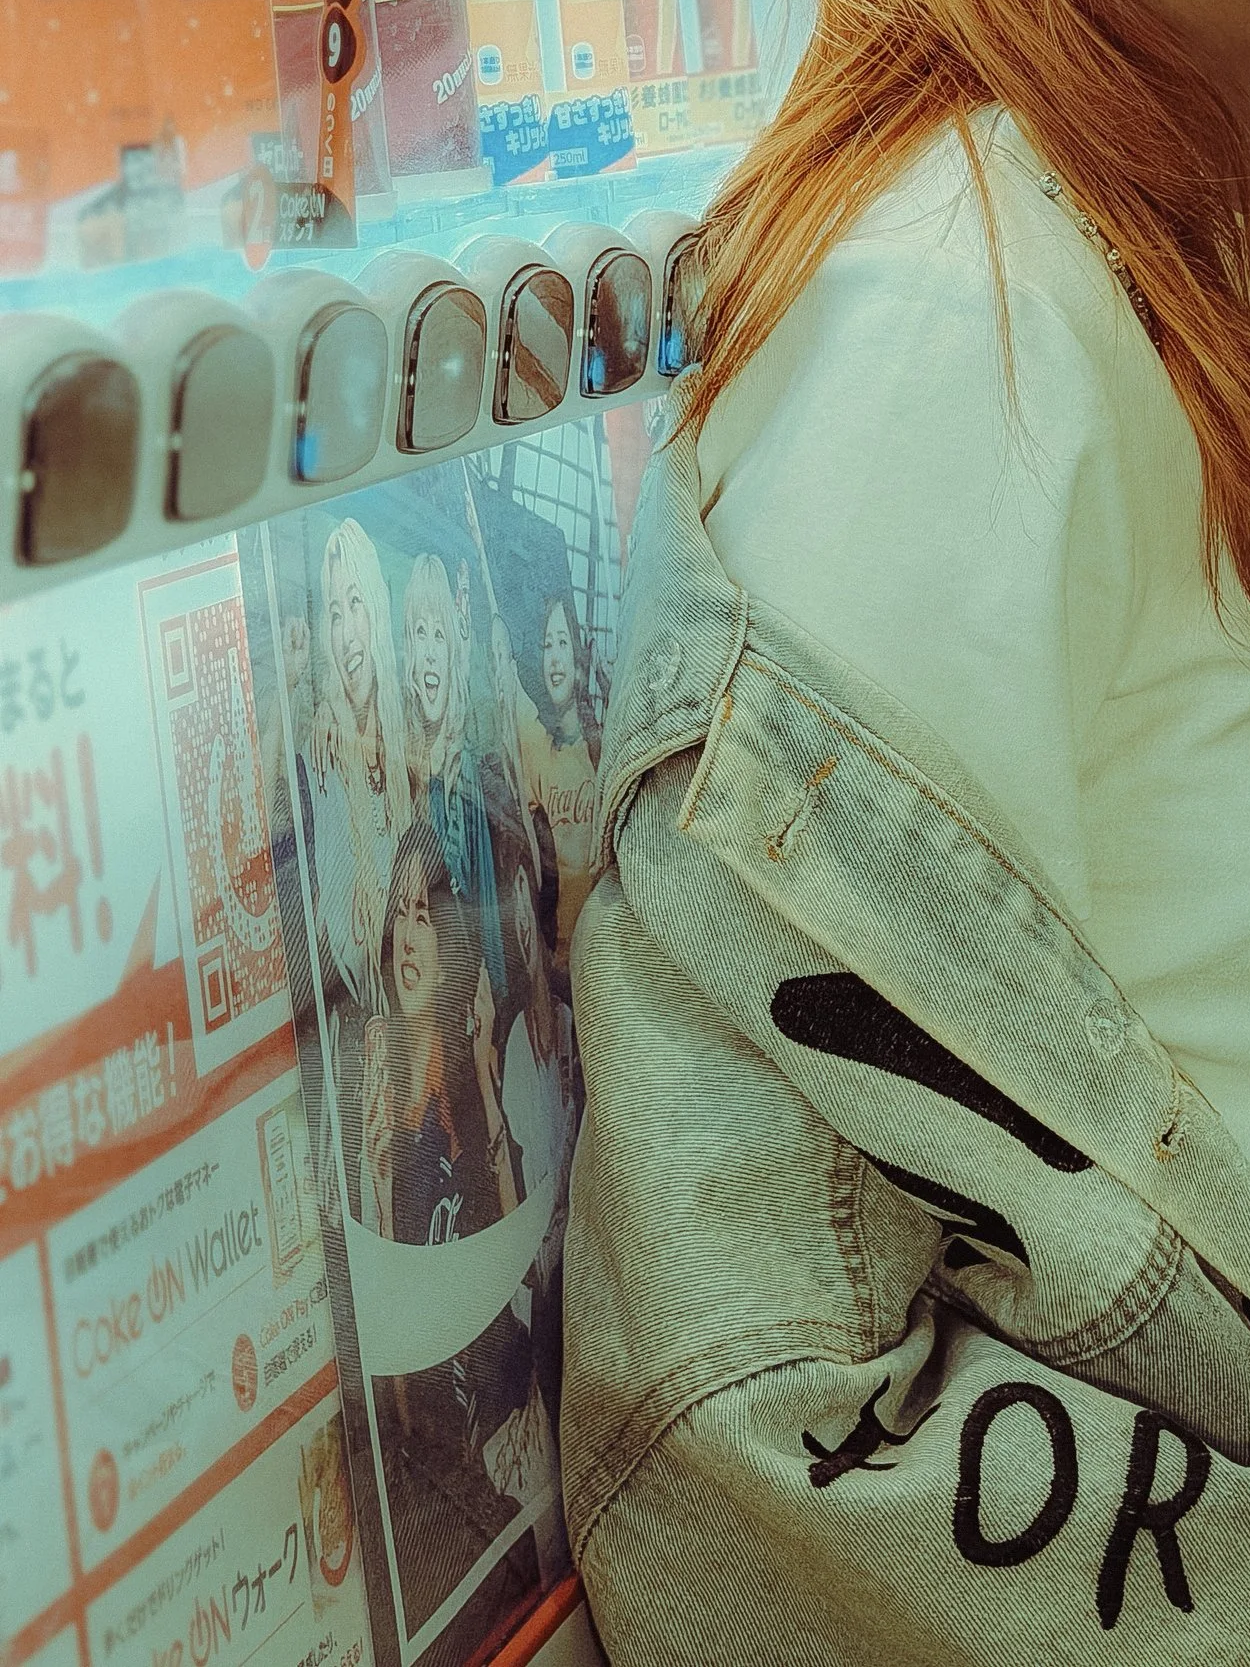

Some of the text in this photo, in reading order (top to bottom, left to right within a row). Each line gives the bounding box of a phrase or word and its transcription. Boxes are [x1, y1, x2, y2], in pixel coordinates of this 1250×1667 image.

[328, 22, 342, 68] 9
[321, 92, 337, 179] のつく日
[553, 149, 586, 165] 250ml
[279, 192, 311, 219] Coke
[74, 1200, 263, 1379] Coke ON Wallet
[231, 1522, 299, 1631] ウォーク
